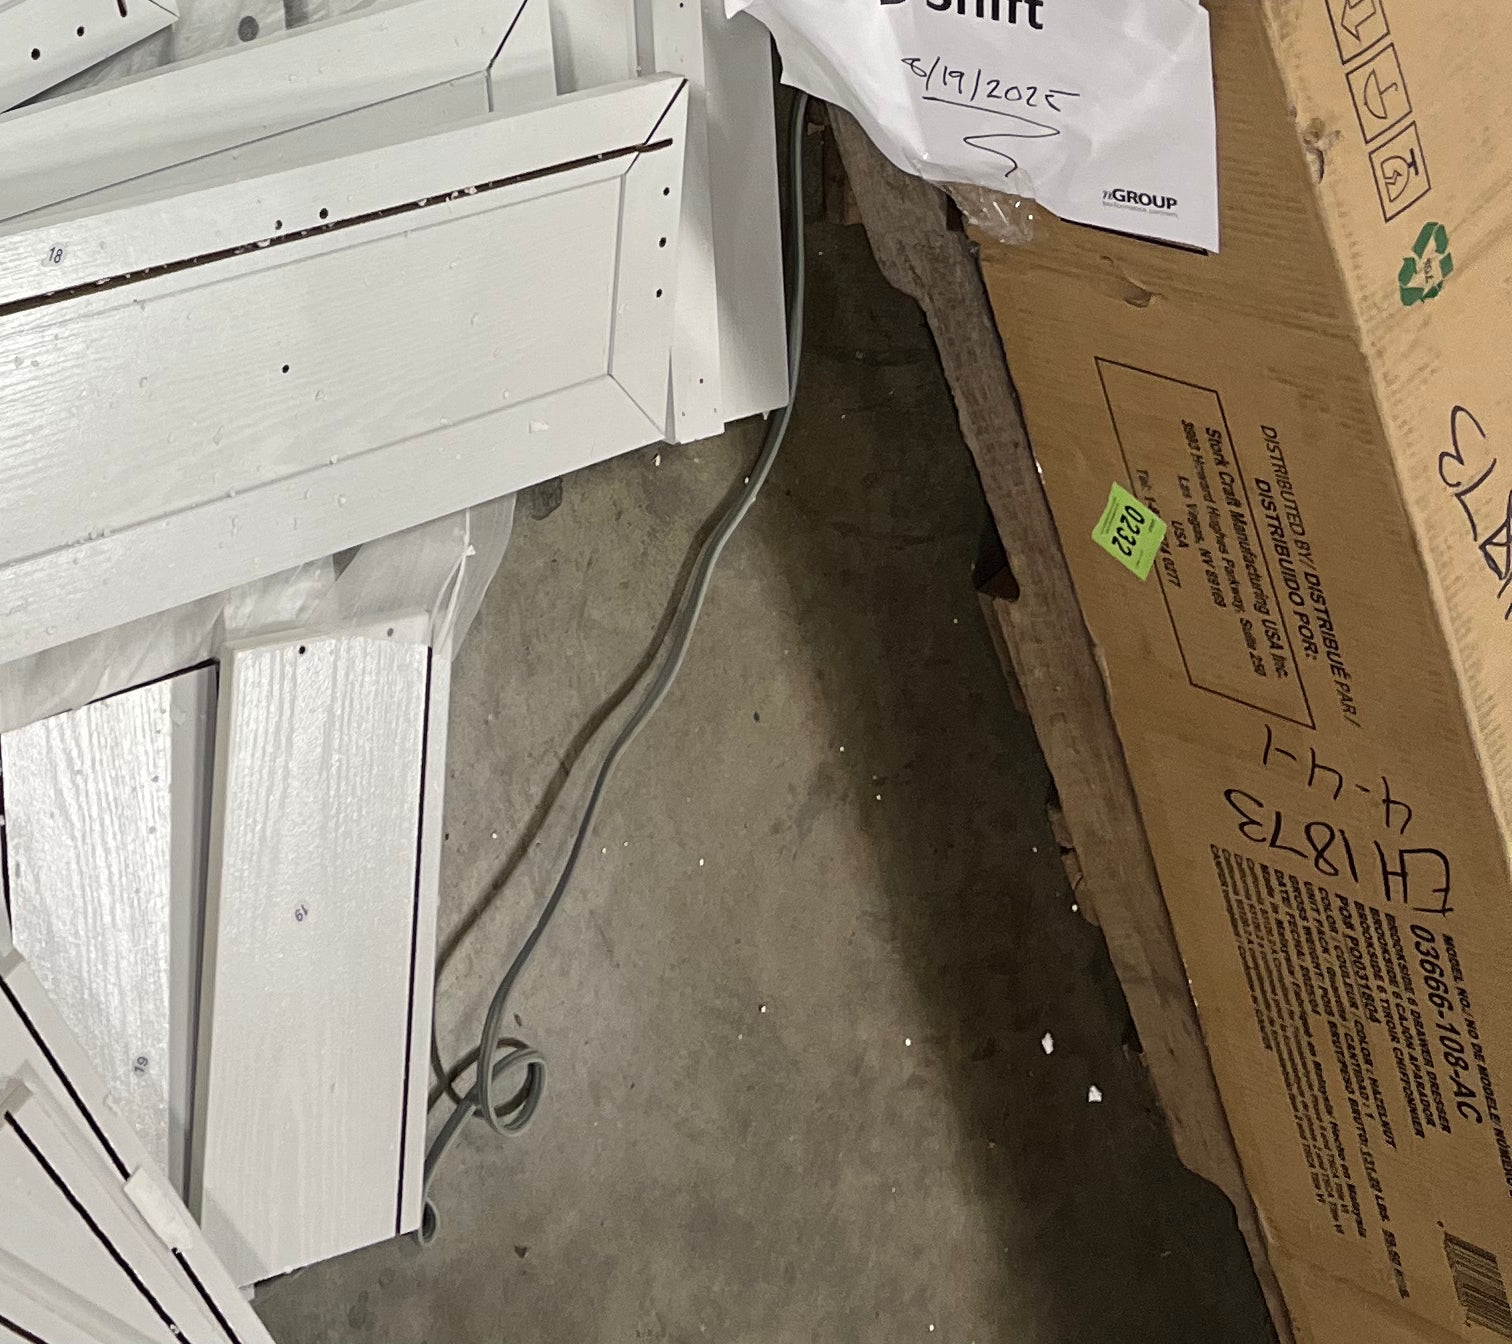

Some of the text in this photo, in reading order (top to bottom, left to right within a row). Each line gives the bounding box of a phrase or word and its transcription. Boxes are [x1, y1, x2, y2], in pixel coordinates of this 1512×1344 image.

[49, 247, 64, 264] 18
[1204, 426, 1229, 467] Stork
[1217, 470, 1242, 507] Craft
[1111, 505, 1145, 557] 0232
[1170, 520, 1189, 549] USA
[1227, 509, 1273, 615] Manufacturing
[1253, 477, 1321, 660] DISTRIBUIDO POR:
[1259, 424, 1307, 536] DISTRIBUTED
[1301, 570, 1352, 681] DISTRIBUÉ
[1332, 680, 1357, 714] PAR
[1259, 617, 1284, 651] USA
[1353, 900, 1384, 983] BROOKSIDE
[1368, 906, 1399, 988] BROOKSIDE
[1442, 933, 1464, 984] MODEL
[1384, 912, 1415, 995] BROOKSIDE
[1426, 1070, 1451, 1134] DRESSER
[1408, 923, 1484, 1124] 03666-108-AC
[135, 1056, 148, 1073] 19
